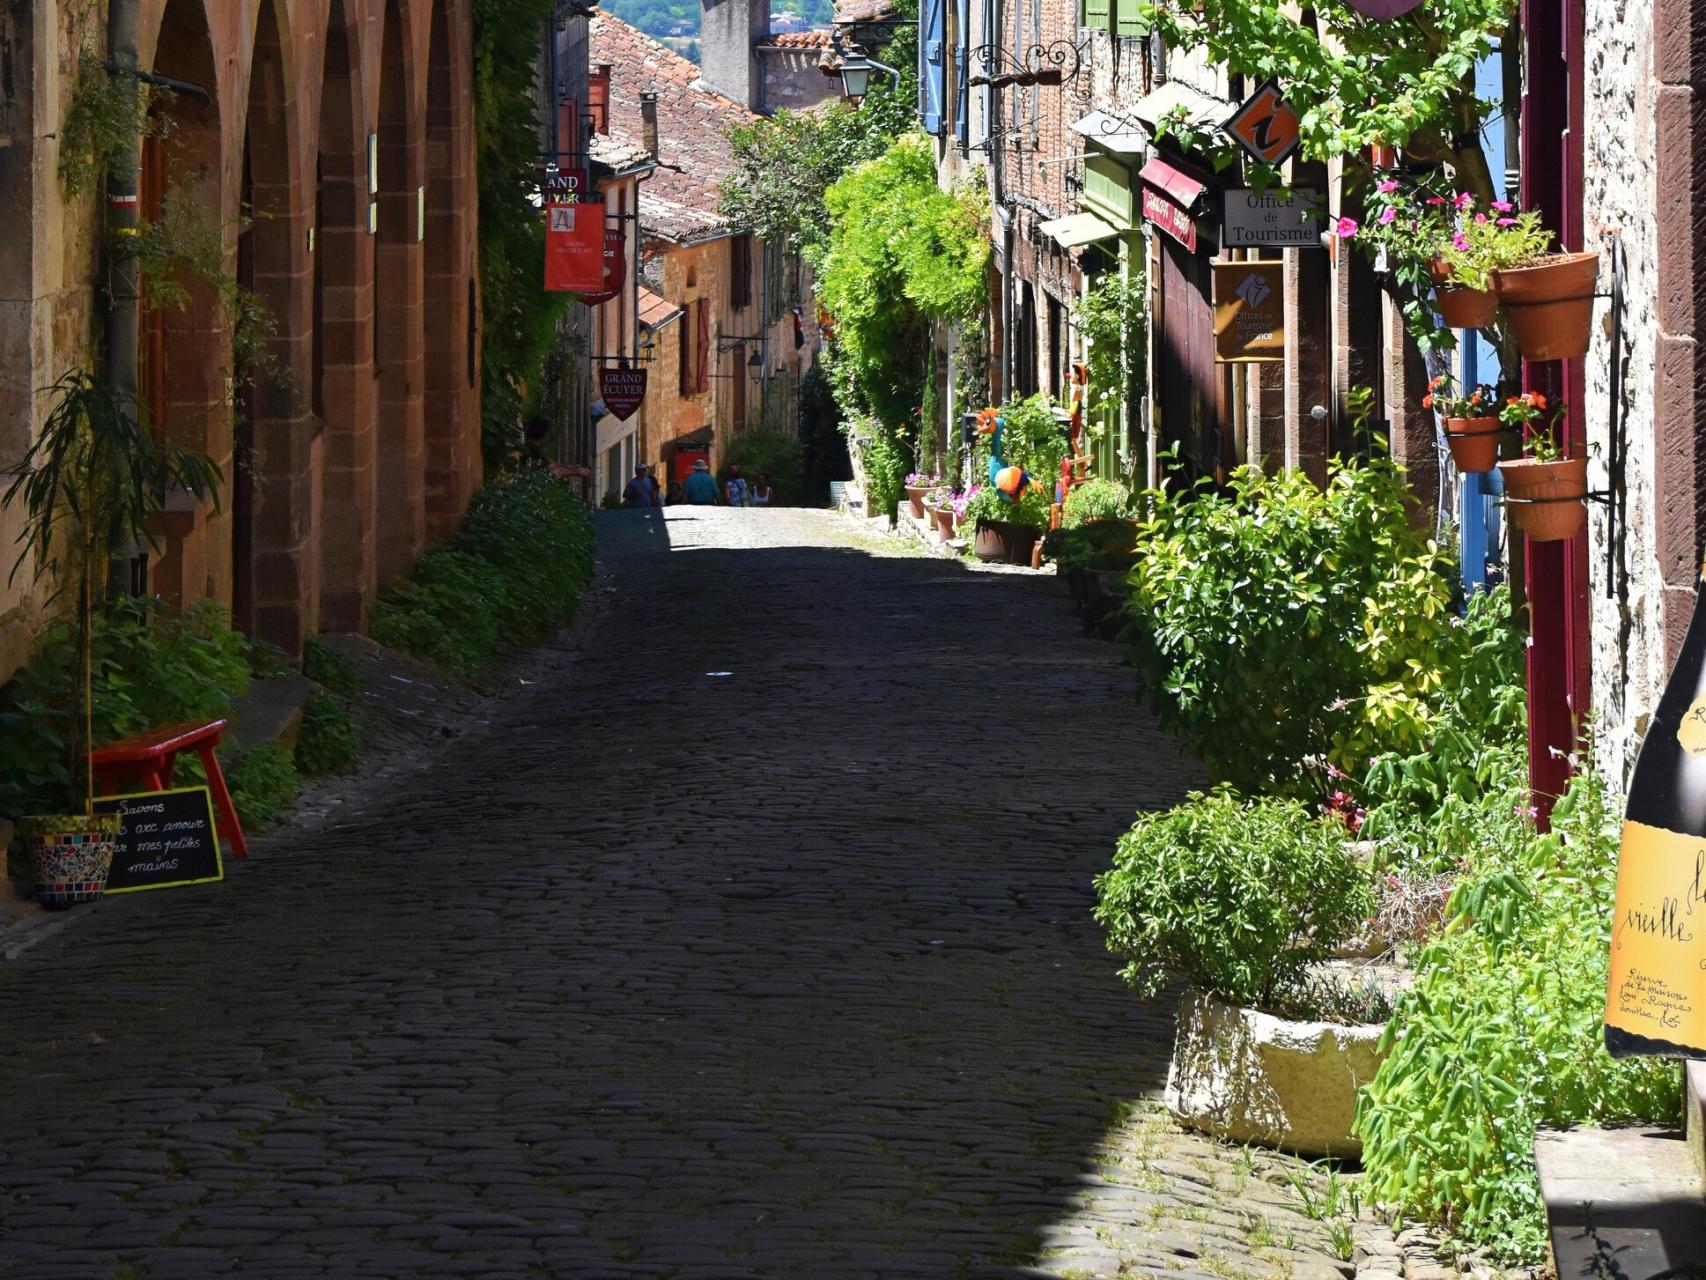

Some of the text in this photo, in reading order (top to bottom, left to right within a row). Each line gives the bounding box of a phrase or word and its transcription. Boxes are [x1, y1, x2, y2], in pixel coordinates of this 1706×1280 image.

[1247, 192, 1295, 209] Office
[1264, 211, 1278, 223] de
[1233, 226, 1313, 241] Tourisme
[1236, 311, 1262, 320] Offices
[1236, 321, 1273, 330] Tourisme
[1245, 331, 1273, 340] France
[605, 374, 641, 383] GRAND
[604, 384, 643, 394] ÉCUYER
[116, 799, 166, 816] Savons
[162, 819, 205, 833] amour
[112, 843, 128, 854] ar
[137, 841, 162, 853] mes
[128, 856, 179, 873] mains
[1617, 896, 1693, 951] vieille
